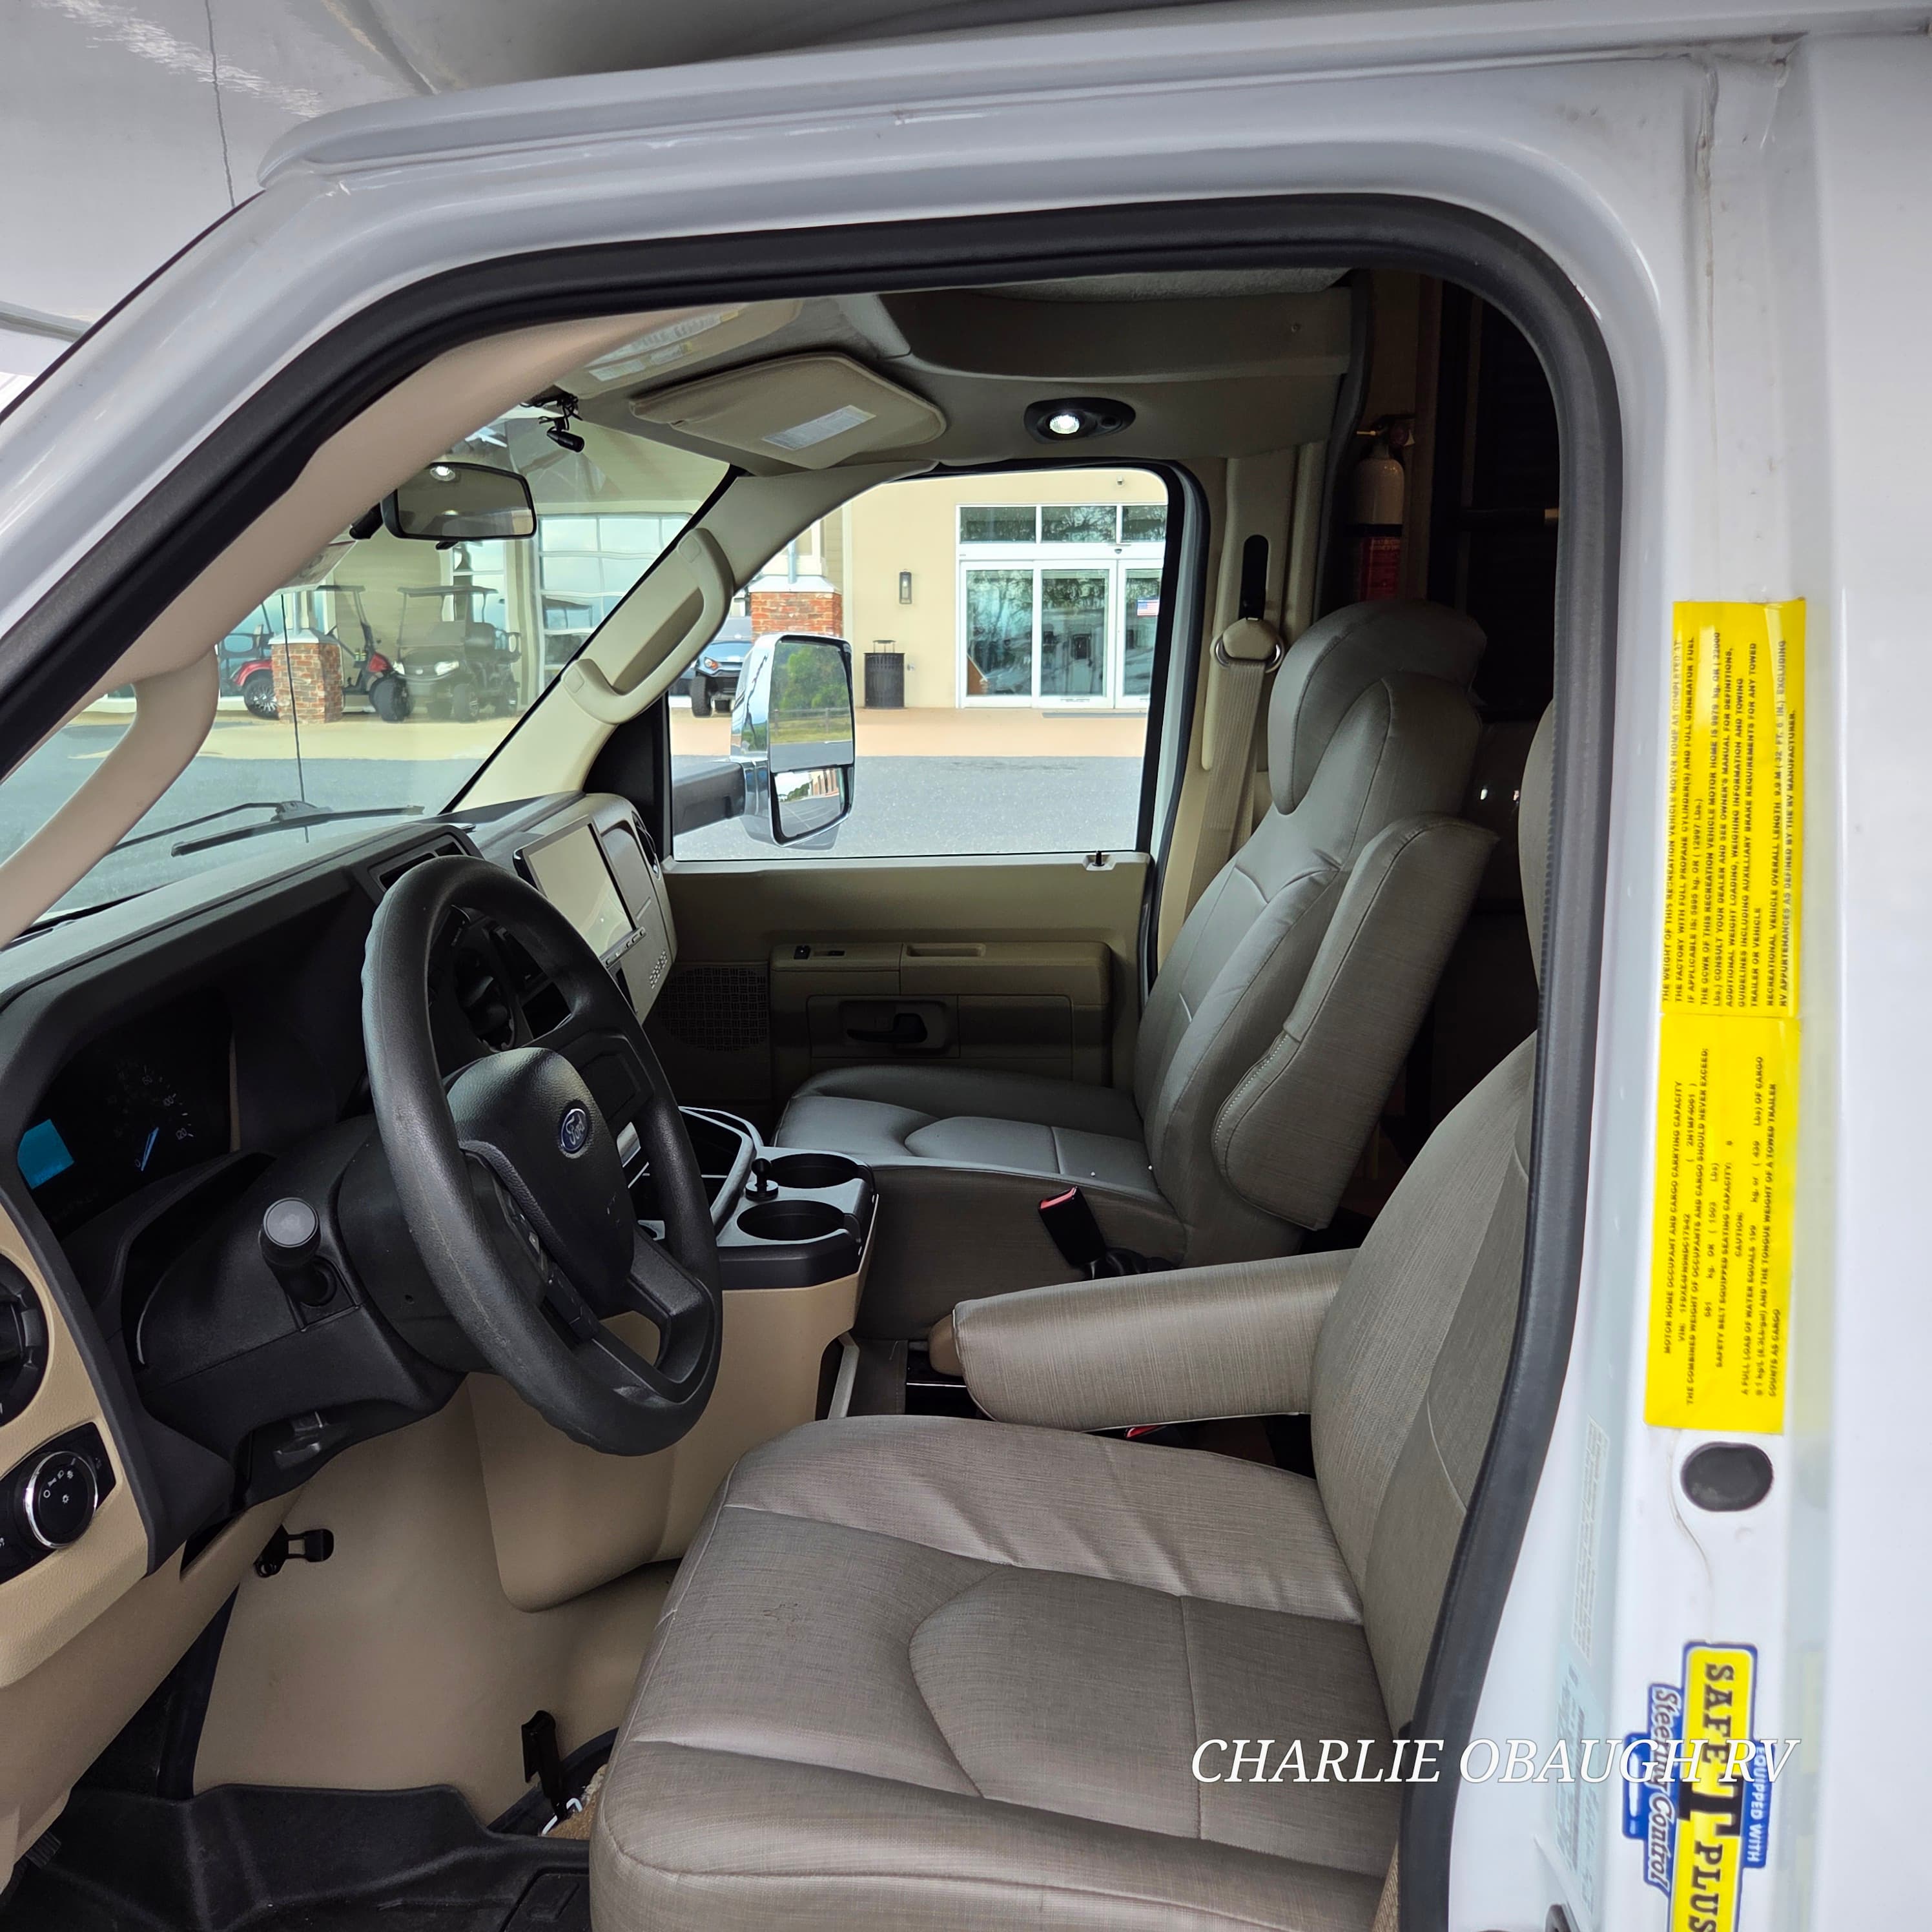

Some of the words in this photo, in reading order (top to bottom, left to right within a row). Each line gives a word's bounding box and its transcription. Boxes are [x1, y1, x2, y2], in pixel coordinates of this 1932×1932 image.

[1712, 669, 1721, 683] OR
[1777, 640, 1787, 695] EXCLUDING
[1671, 715, 1680, 726] AS
[1711, 729, 1719, 738] IS
[1670, 730, 1679, 757] HOME
[1745, 723, 1754, 797] REQUIREMENTS
[1774, 752, 1782, 762] 32
[1669, 761, 1678, 794] MOTOR
[1708, 772, 1716, 806] MOTOR
[1732, 742, 1742, 807] INFORMATION
[1668, 797, 1677, 837] VEHICLE
[1681, 773, 1691, 832] CYLINDER(S)
[1786, 795, 1794, 807] RV
[1786, 810, 1794, 830] THE
[1707, 809, 1715, 849] VEHICLE
[1731, 810, 1740, 858] WEIGHING
[1773, 803, 1782, 840] LENGTH
[1785, 833, 1793, 846] BY
[1666, 840, 1675, 900] RECREATION
[1714, 938, 1723, 981] CONSULT
[1721, 735, 1730, 775] MANUAL
[1771, 843, 1780, 887] OVERALL
[1784, 848, 1793, 889] DEFINED
[1678, 883, 1687, 907] FULL
[1704, 852, 1713, 912] RECREATION
[1783, 893, 1792, 905] AS
[1665, 903, 1673, 926] THIS
[1688, 934, 1696, 992] APPLICABLE
[1692, 861, 1699, 874] OR
[1703, 916, 1711, 938] THIS
[1740, 895, 1749, 947] INCLUDING
[1752, 908, 1761, 948] VEHICLE
[1769, 890, 1778, 930] VEHICLE
[1664, 929, 1672, 940] OF
[1703, 941, 1710, 953] OF
[1780, 909, 1789, 991] APPURTENANCES
[1663, 943, 1671, 981] WEIGHT
[1676, 939, 1684, 981] FACTORY
[1752, 952, 1759, 965] OR
[1767, 934, 1776, 1006] RECREATIONAL
[1700, 988, 1709, 1005] THE
[1726, 951, 1734, 1007] ADDITIONAL
[1738, 951, 1747, 1007] GUIDELINES
[1751, 969, 1759, 1007] TRAILER
[1779, 994, 1787, 1007] RV
[1755, 1056, 1763, 1089] CARGO
[1673, 1082, 1682, 1127] CAPACITY
[1754, 1092, 1762, 1104] OF
[1767, 1084, 1776, 1123] TRAILER
[175, 1127, 187, 1140] 120
[566, 1112, 585, 1146] Ford
[1696, 1124, 1705, 1162] SHOULD
[1671, 1130, 1680, 1178] CARRYING
[1765, 1171, 1773, 1183] OF
[1670, 1180, 1678, 1213] CARGO
[1763, 1186, 1772, 1222] WEIGHT
[1692, 1222, 1701, 1278] OCCUPANTS
[1707, 1244, 1714, 1257] OR
[1721, 1214, 1730, 1255] SEATING
[1762, 1226, 1771, 1264] TONGUE
[1667, 1238, 1676, 1288] OCCUPANT
[1720, 1258, 1728, 1304] EQUIPPED
[1747, 1246, 1756, 1284] EQUALS
[1665, 1291, 1674, 1318] HOME
[1691, 1281, 1698, 1293] OF
[1689, 1297, 1698, 1331] WEIGHT
[1744, 1321, 1752, 1333] OF
[1772, 1309, 1780, 1342] CARGO
[1687, 1335, 1696, 1384] COMBINED
[1716, 1333, 1724, 1368] SAFETY
[1743, 1336, 1752, 1360] LOAD
[1771, 1344, 1779, 1357] AS
[1742, 1364, 1750, 1386] FULL
[1769, 1359, 1778, 1397] COUNTS
[1701, 1663, 1735, 1763] SAFE
[1751, 1746, 1767, 1820] EQUIPPED
[1651, 1796, 1672, 1887] Control
[1746, 1824, 1763, 1862] WITH
[1688, 1840, 1723, 1932] PLUS
